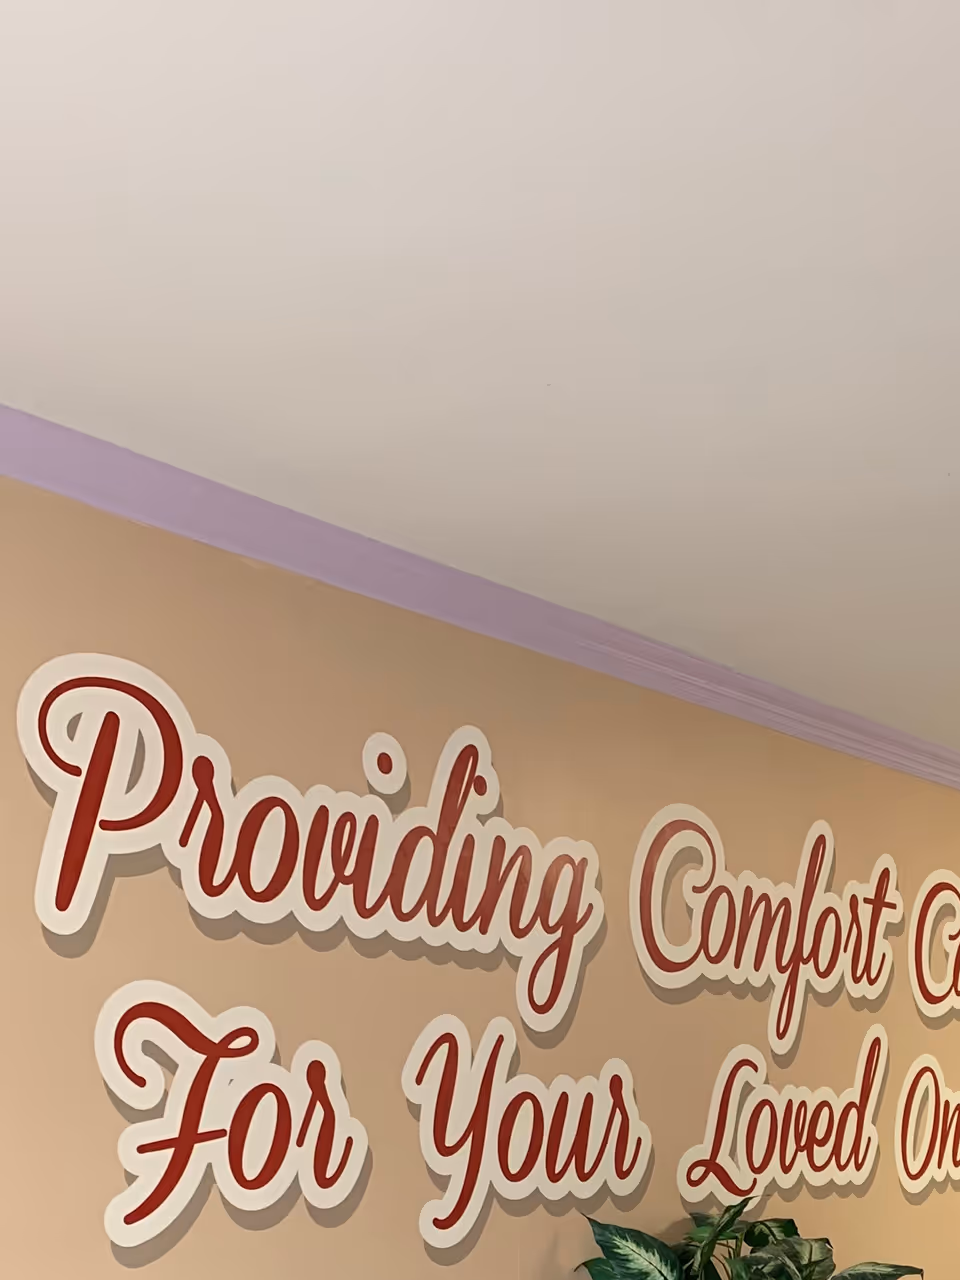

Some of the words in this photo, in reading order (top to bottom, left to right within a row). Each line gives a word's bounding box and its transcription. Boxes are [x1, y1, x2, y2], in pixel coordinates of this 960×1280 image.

[38, 676, 594, 1015] Providing
[639, 818, 897, 1041] Comfort
[114, 1001, 354, 1225] For
[415, 1032, 642, 1231] Your
[686, 1036, 878, 1198] Loved
